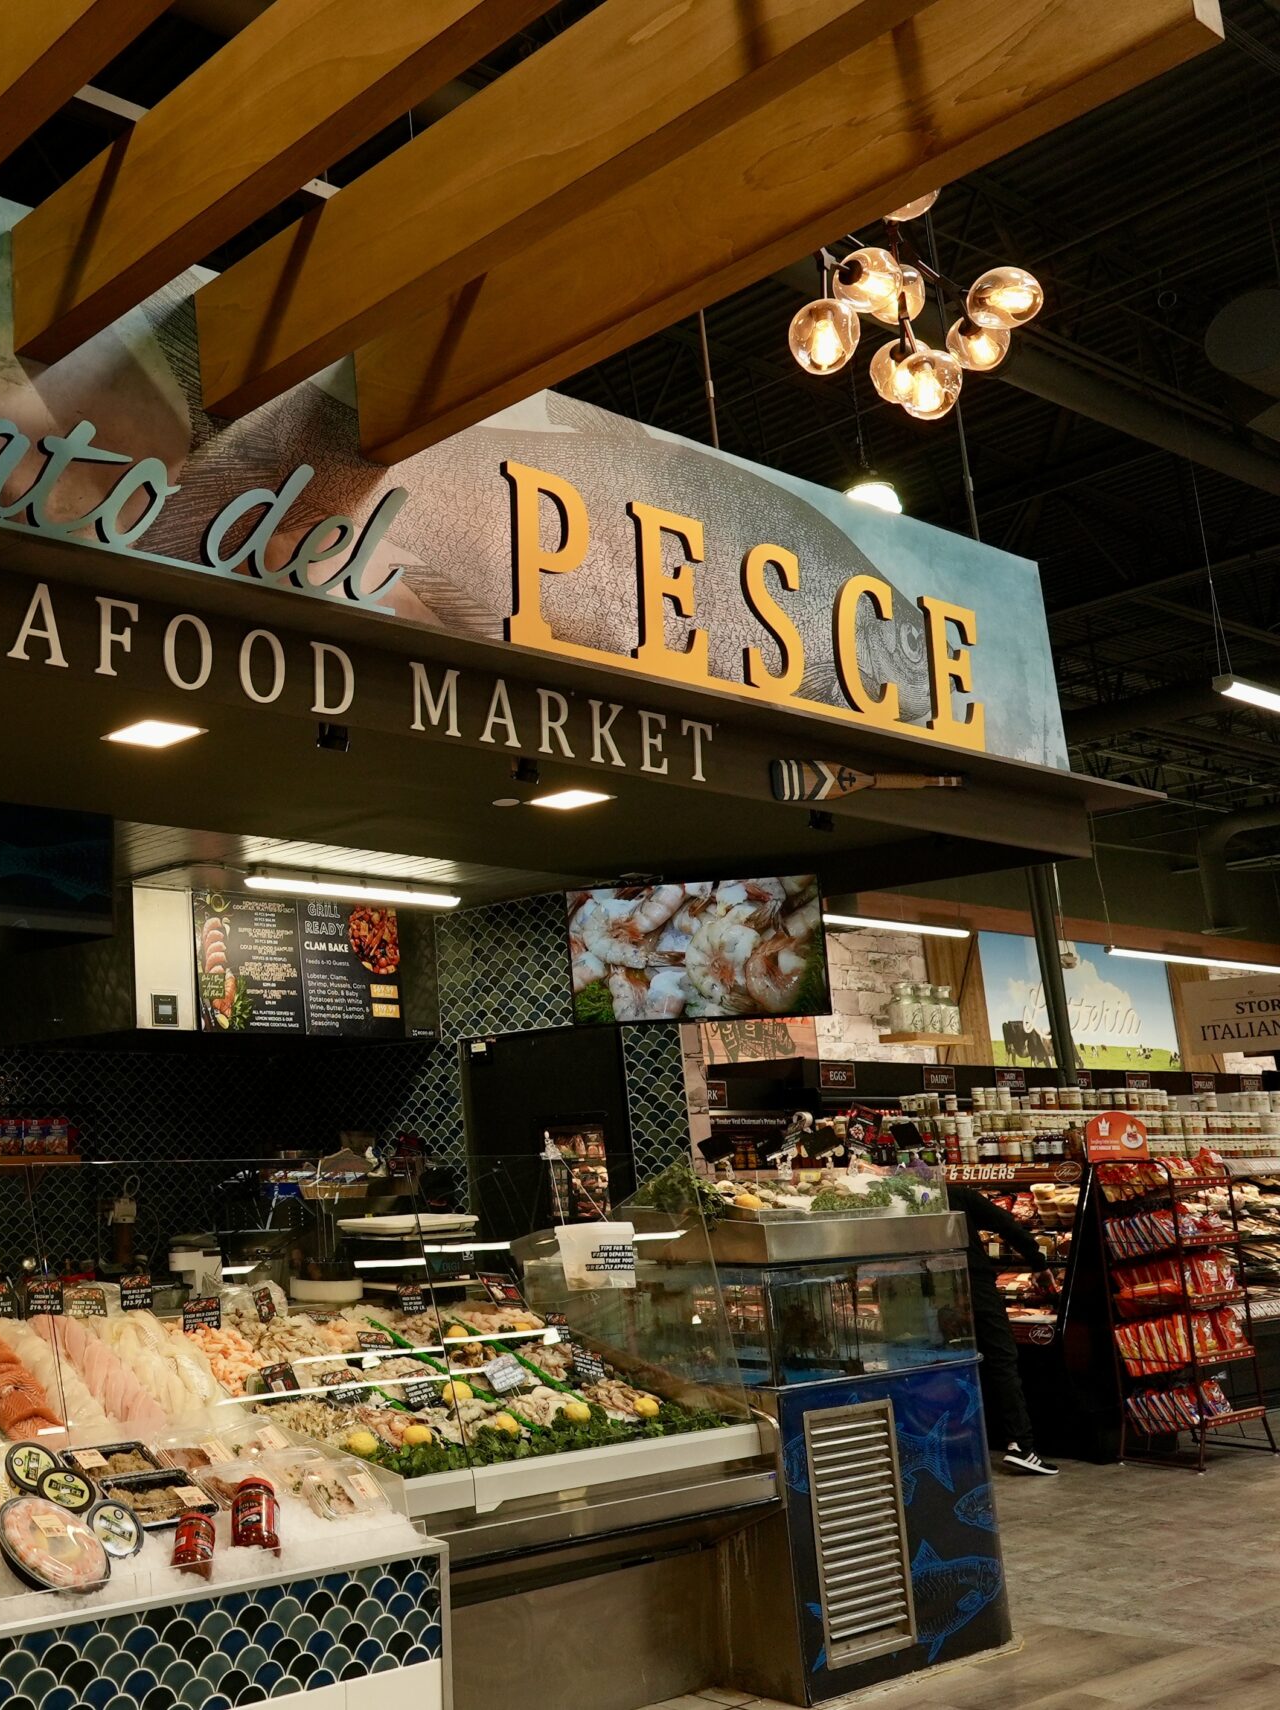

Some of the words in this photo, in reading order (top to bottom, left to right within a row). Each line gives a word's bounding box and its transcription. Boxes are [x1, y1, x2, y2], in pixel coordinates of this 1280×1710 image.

[202, 464, 408, 610] del
[500, 460, 985, 750] PESCE
[410, 661, 714, 782] MARKET
[307, 903, 340, 918] GRILL
[304, 921, 345, 936] READY
[304, 941, 327, 951] CLAM
[328, 943, 349, 953] BAKE
[333, 959, 350, 967] Guests
[1200, 1020, 1280, 1041] ITALIAN
[829, 1071, 847, 1081] EGGS
[930, 1074, 948, 1084] DAIRY
[1128, 1079, 1148, 1088] YOGURT
[1194, 1080, 1214, 1089] SPREADS
[708, 1090, 718, 1100] RK
[950, 1168, 958, 1180] &
[962, 1167, 1015, 1180] SLIDERS
